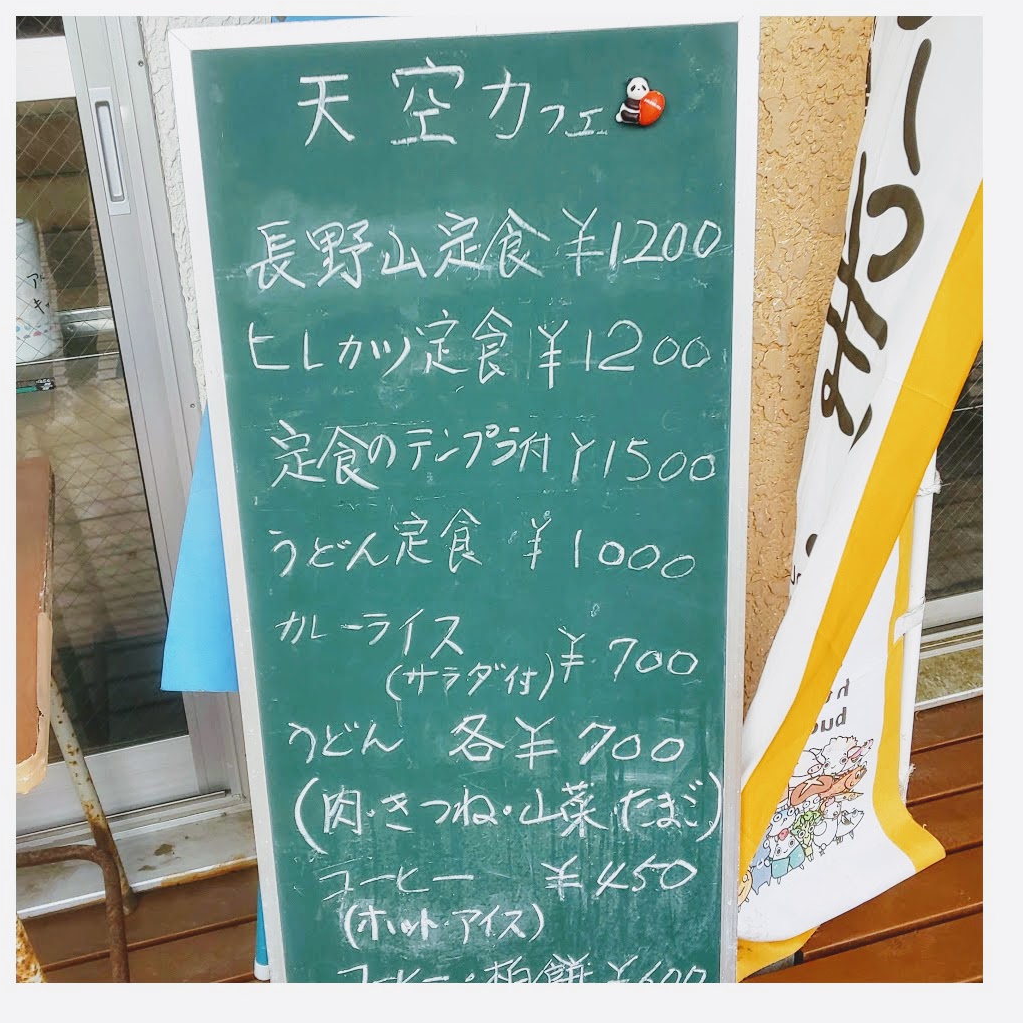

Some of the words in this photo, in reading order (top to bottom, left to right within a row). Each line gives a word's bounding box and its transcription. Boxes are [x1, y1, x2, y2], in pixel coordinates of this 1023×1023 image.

[298, 57, 607, 146] 天空カフェ
[246, 208, 550, 292] 長野山定食
[562, 208, 721, 276] ¥1200
[249, 307, 512, 384] ヒレカツ定食
[538, 320, 710, 389] ¥1200
[269, 508, 482, 577] うどん定食
[275, 608, 464, 660] カレーライス
[289, 723, 403, 763] うどん
[319, 866, 474, 900] コーヒー
